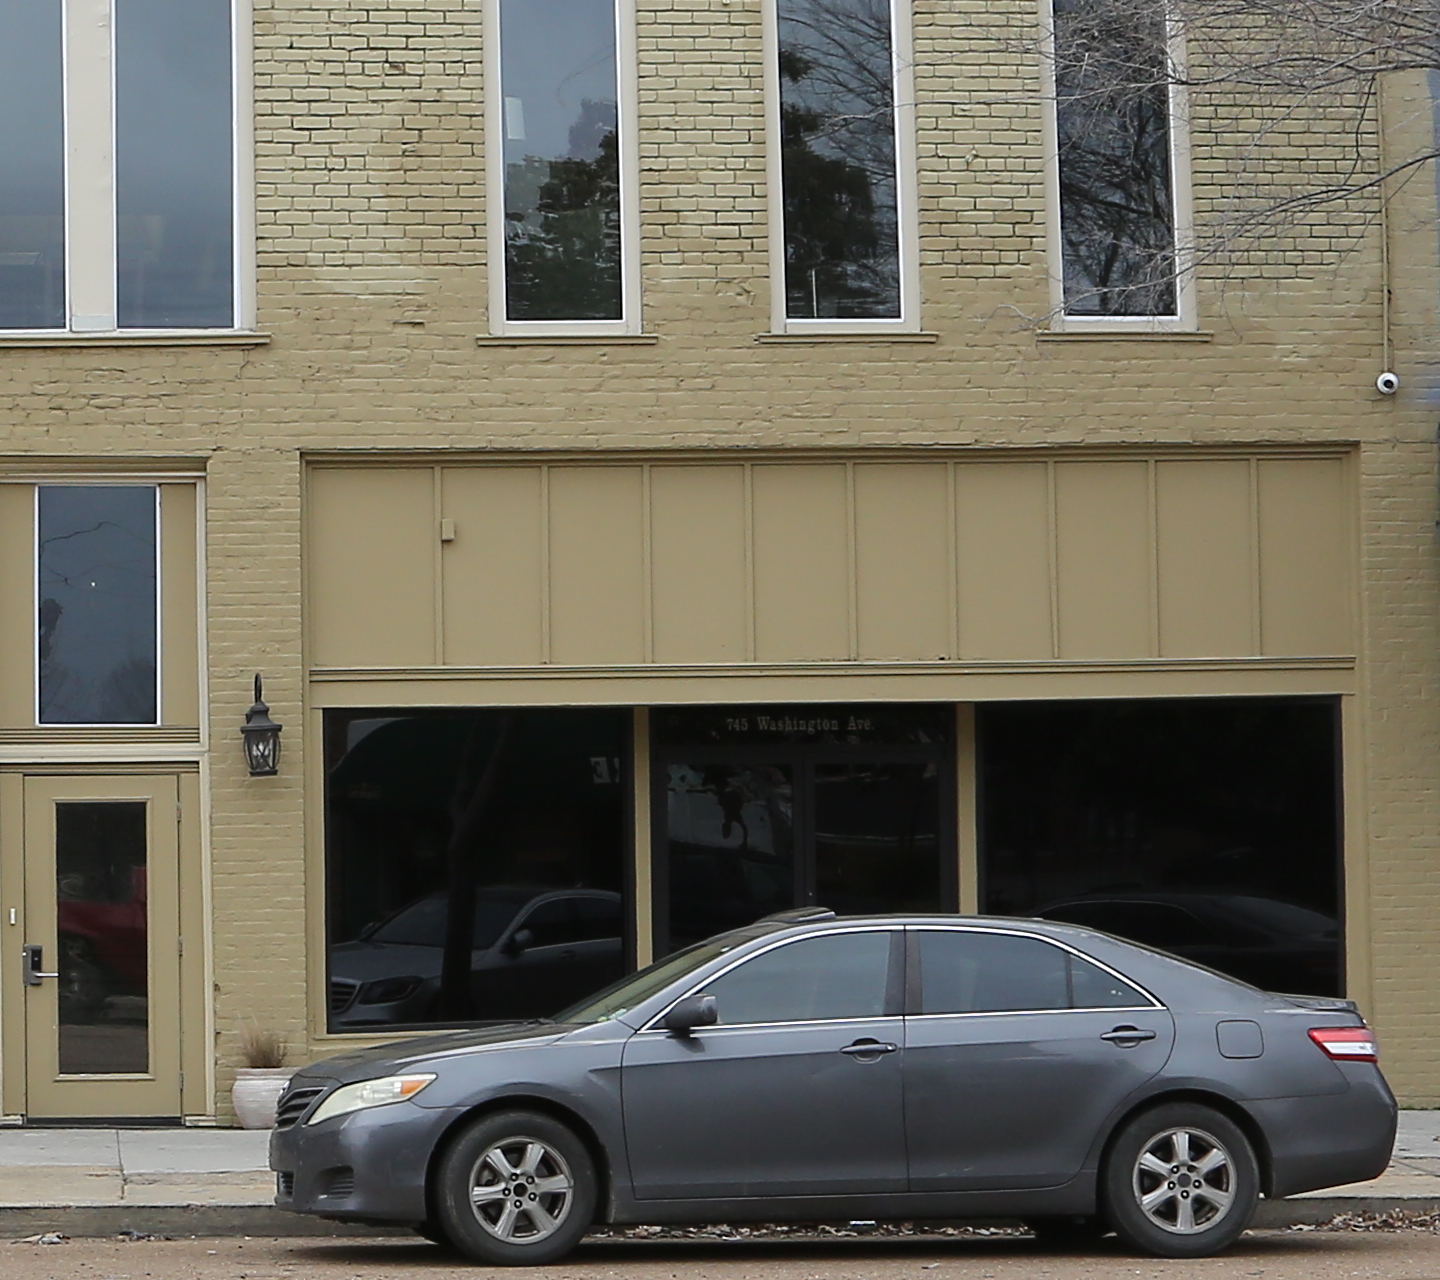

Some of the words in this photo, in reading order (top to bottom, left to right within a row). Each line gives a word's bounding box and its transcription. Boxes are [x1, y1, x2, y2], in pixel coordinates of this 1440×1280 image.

[726, 718, 748, 731] 745
[757, 716, 839, 735] Washington
[847, 716, 876, 731] Ave.
